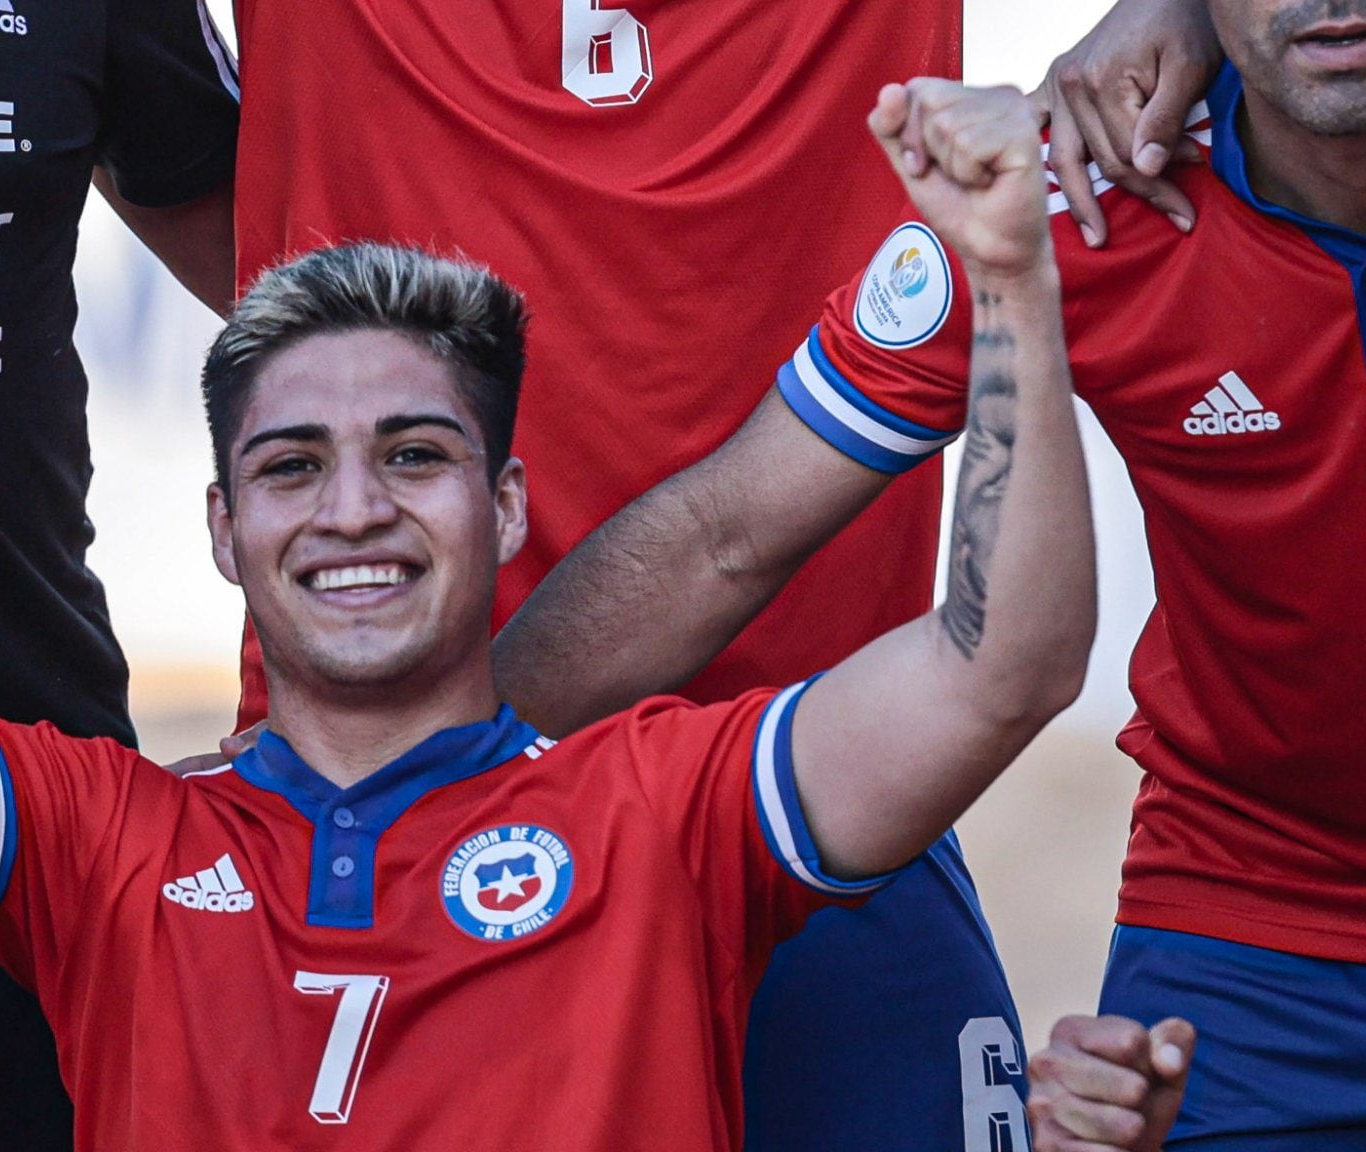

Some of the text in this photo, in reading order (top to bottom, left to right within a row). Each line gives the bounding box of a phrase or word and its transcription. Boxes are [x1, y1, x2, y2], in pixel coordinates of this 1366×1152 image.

[877, 292, 902, 328] AMERICA
[1183, 410, 1281, 435] adidas
[443, 827, 570, 897] FEDERACION DE FUTBOL
[163, 883, 254, 912] adidas
[484, 908, 553, 939] DE CHILE
[293, 970, 390, 1124] 7
[958, 1016, 1032, 1152] 6
